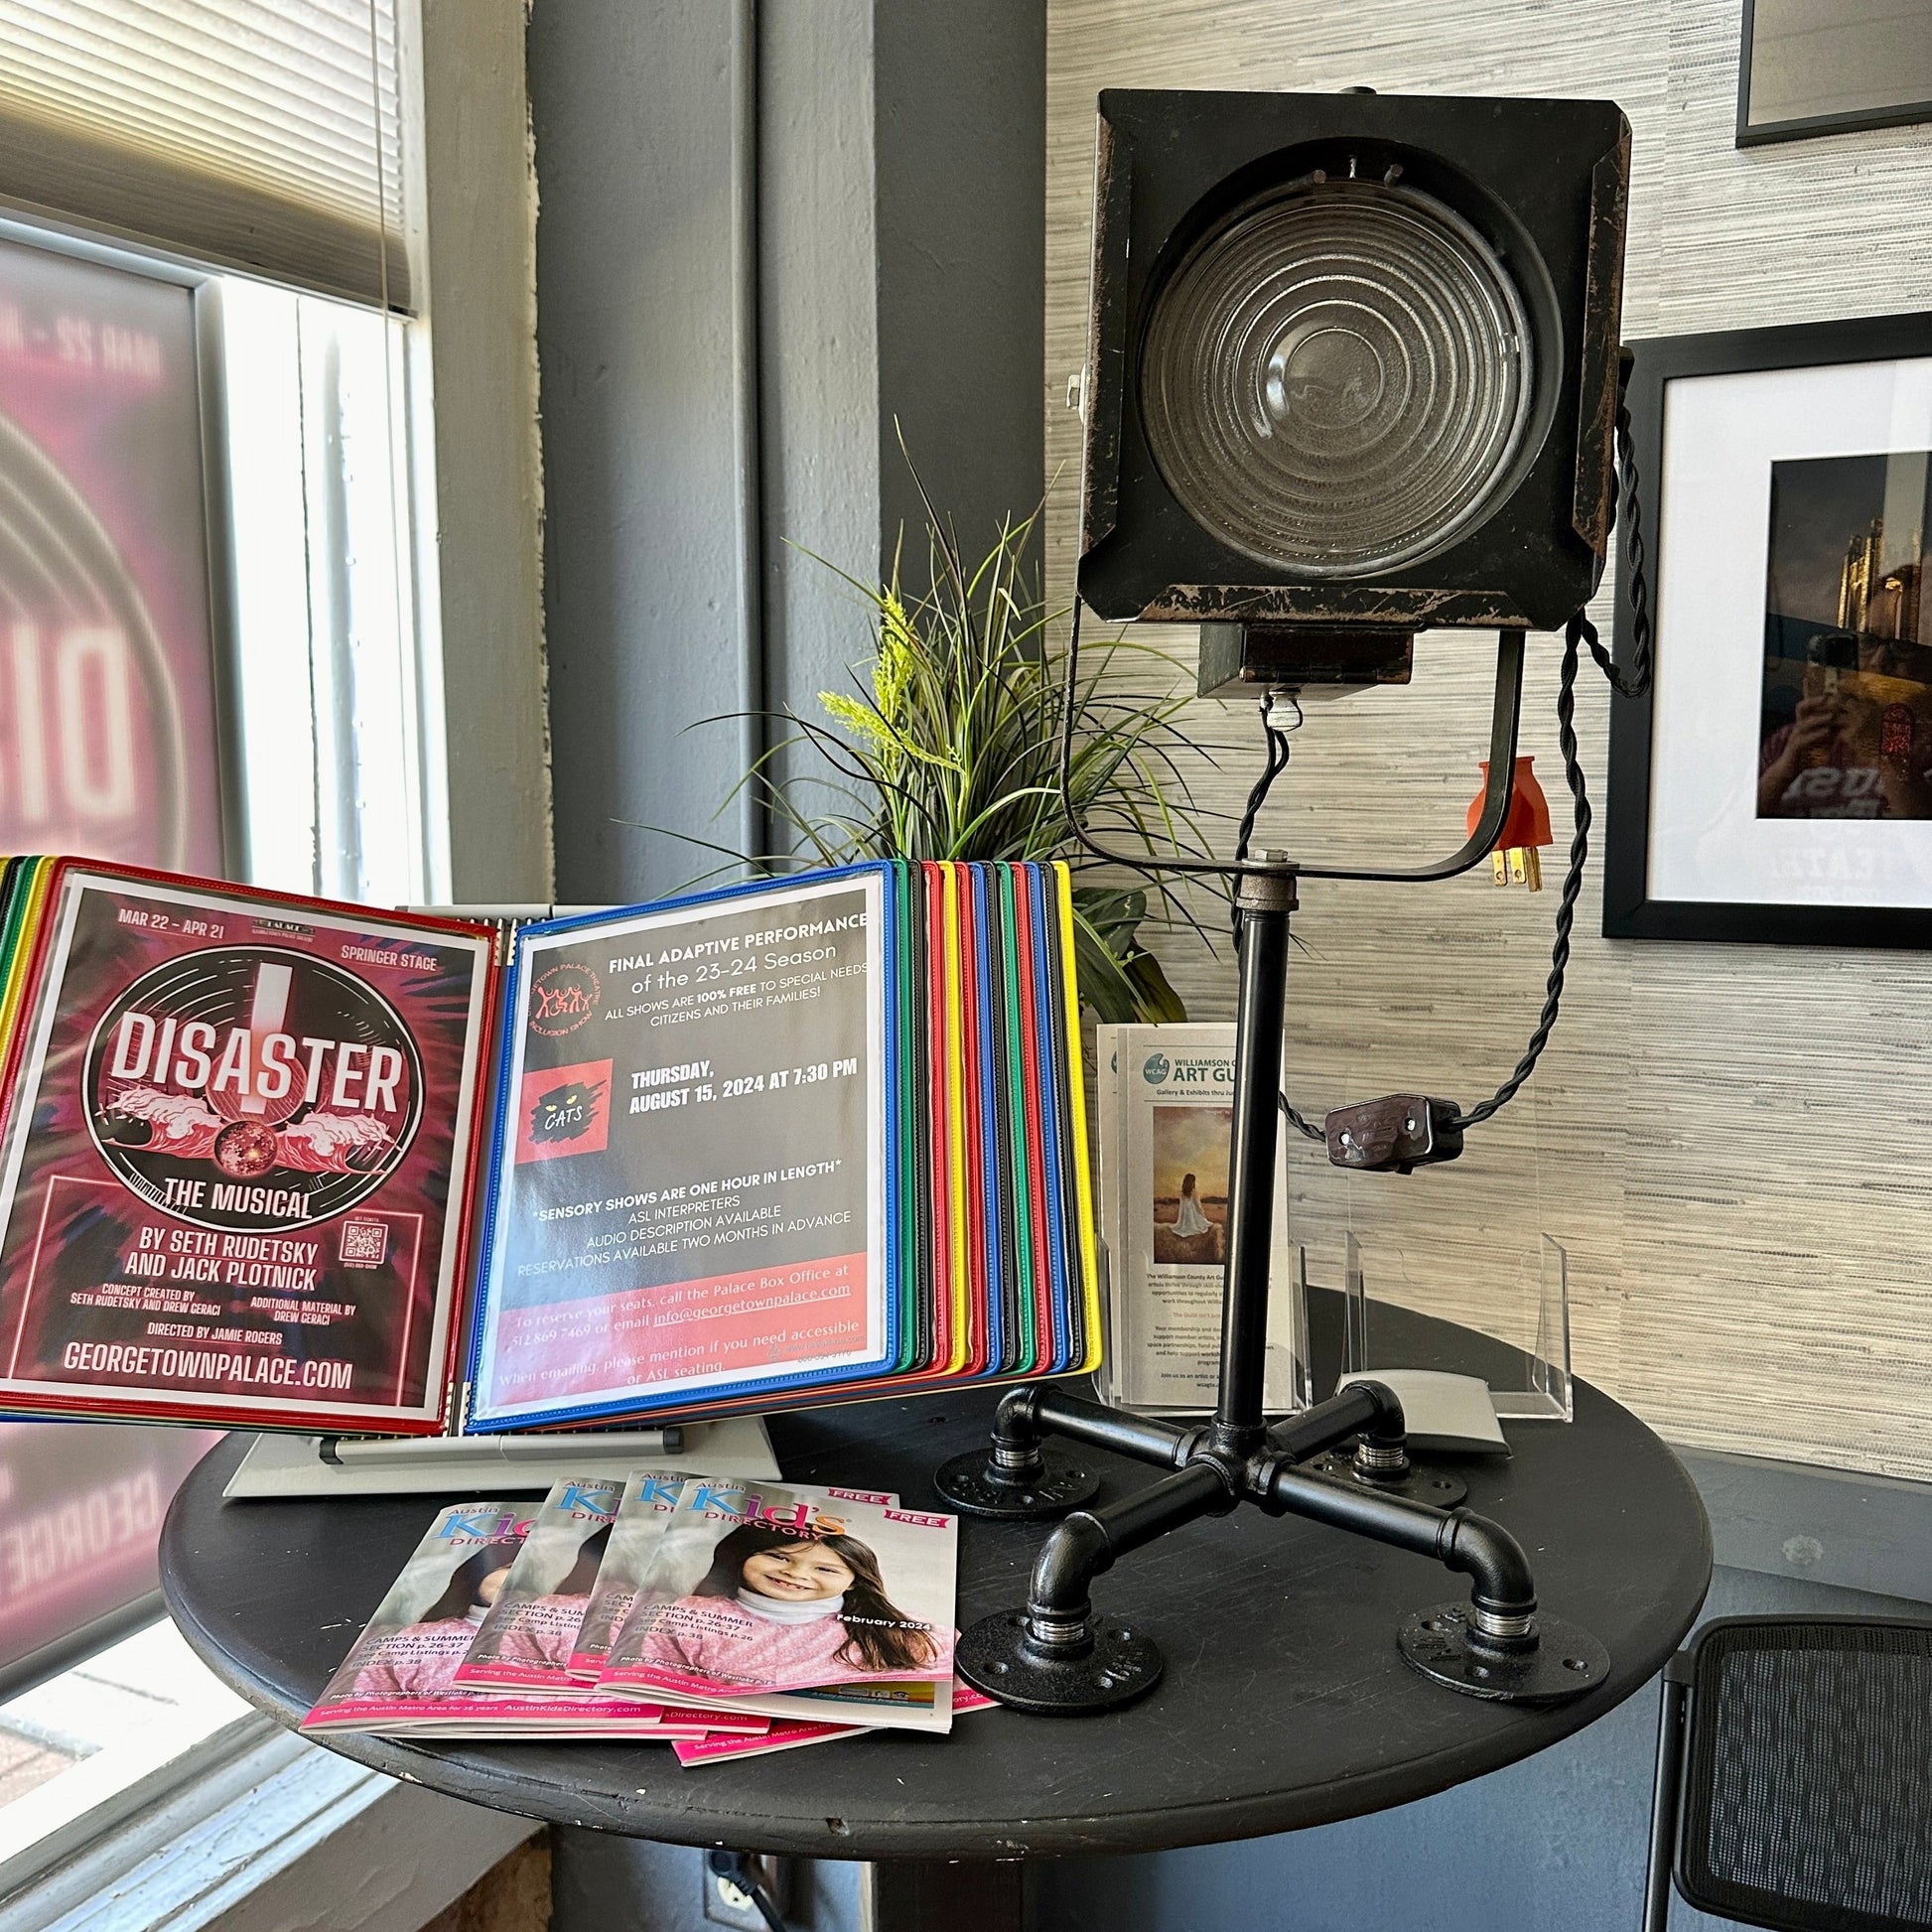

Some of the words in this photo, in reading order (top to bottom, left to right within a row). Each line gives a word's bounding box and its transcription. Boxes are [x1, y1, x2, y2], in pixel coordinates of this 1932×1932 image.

[118, 908, 148, 926] MAR
[151, 914, 170, 930] 22
[183, 919, 207, 936] APR
[210, 925, 223, 939] 21
[609, 954, 654, 974] FINAL
[658, 936, 740, 965] ADAPTIVE
[745, 912, 867, 949] PERFORMANCE
[342, 945, 397, 966] SPRINGER
[400, 954, 437, 971] STAGE
[631, 975, 651, 994] of
[657, 970, 688, 990] the
[695, 956, 758, 983] 23-24
[763, 946, 836, 970] Season
[605, 1010, 623, 1021] ALL
[626, 1000, 669, 1017] SHOWS
[672, 995, 694, 1009] ARE
[697, 989, 727, 1004] 100%
[729, 984, 757, 998] FREE
[759, 981, 776, 993] TO
[779, 971, 827, 989] SPECIAL
[830, 962, 868, 979] NEEDS
[650, 1011, 701, 1027] CITIZENS
[704, 1005, 729, 1017] AND
[733, 999, 763, 1012] THEIR
[765, 987, 821, 1006] FAMILIES!
[629, 1088, 691, 1114] AUGUST
[695, 1084, 717, 1103] 15,
[723, 1075, 764, 1099] 2024
[768, 1070, 789, 1090] AT
[793, 1062, 827, 1085] 7:30
[832, 1057, 858, 1077] PM
[631, 1060, 714, 1089] THURSDAY,
[1173, 1068, 1208, 1081] ART
[545, 1106, 582, 1130] CATS
[162, 1177, 205, 1209] THE
[211, 1184, 312, 1220] MUSICAL
[605, 1191, 657, 1212] SHOWS
[660, 1186, 687, 1202] ARE
[689, 1181, 718, 1197] ONE
[722, 1173, 761, 1192] HOUR
[763, 1172, 776, 1184] IN
[628, 1210, 650, 1224] ASL
[654, 1195, 741, 1220] INTERPRETERS
[586, 1231, 626, 1249] AUDIO
[629, 1217, 712, 1242] DESCRIPTION
[715, 1205, 781, 1227] AVAILABLE
[139, 1227, 167, 1249] BY
[170, 1230, 218, 1255] SETH
[222, 1235, 318, 1265] RUDETSKY
[517, 1252, 611, 1277] RESERVATIONS
[613, 1242, 678, 1262] AVAILABLE
[681, 1236, 711, 1250] TWO
[714, 1226, 768, 1245] MONTHS
[771, 1223, 784, 1235] IN
[786, 1210, 851, 1233] ADVANCE
[124, 1252, 166, 1276] AND
[171, 1257, 220, 1282] JACK
[226, 1261, 317, 1291] PLOTNICK
[70, 1293, 93, 1306] SETH
[95, 1295, 140, 1309] RUDETSKY
[142, 1299, 161, 1311] AND
[163, 1301, 190, 1313] DREW
[191, 1303, 220, 1315] GERACI
[102, 1284, 141, 1298] CONCEPT
[144, 1287, 181, 1301] CREATED
[183, 1291, 195, 1302] BY
[251, 1297, 299, 1311] ADDITIONAL
[303, 1301, 343, 1314] MATERIAL
[345, 1305, 355, 1315] BY
[536, 1309, 584, 1325] reserve
[586, 1302, 616, 1321] your
[660, 1291, 682, 1305] call
[687, 1288, 709, 1301] the
[714, 1278, 756, 1298] Palace
[759, 1275, 784, 1289] Box
[789, 1268, 831, 1284] Office
[835, 1264, 849, 1276] at
[273, 1311, 298, 1323] DREW
[301, 1313, 331, 1325] GERACI
[595, 1323, 610, 1334] or
[614, 1314, 649, 1330] email
[653, 1283, 851, 1327] info@georgetownpalace.com
[147, 1322, 194, 1337] DIRECTED
[198, 1326, 209, 1338] BY
[211, 1327, 241, 1342] JAMIE
[244, 1330, 283, 1345] ROGERS
[64, 1342, 352, 1389] GEORGETOWNPALACE.COM
[499, 1370, 536, 1386] When
[604, 1353, 645, 1373] please
[649, 1343, 705, 1363] mention
[709, 1340, 719, 1353] if
[723, 1337, 748, 1353] you
[753, 1329, 786, 1346] need
[790, 1319, 860, 1340] accessible
[626, 1374, 641, 1384] or
[646, 1369, 668, 1381] ASL
[565, 1480, 615, 1491] Austin
[697, 1481, 746, 1491] Austin
[834, 1490, 884, 1503] FREE
[449, 1506, 499, 1515] Austin
[687, 1487, 847, 1536] Kid's
[890, 1512, 940, 1526] FREE
[705, 1511, 824, 1540] DIRECTORY
[642, 1611, 693, 1620] SECTION
[644, 1604, 687, 1613] CAMPS
[701, 1611, 753, 1627] SUMMER
[837, 1613, 896, 1627] February
[899, 1620, 931, 1630] 2024
[361, 1642, 415, 1651] SECTION
[366, 1636, 412, 1645] CAMPS
[661, 1675, 689, 1686] Austin
[691, 1683, 717, 1693] Metro
[503, 1704, 640, 1714] AustinKidsDirectory.com
